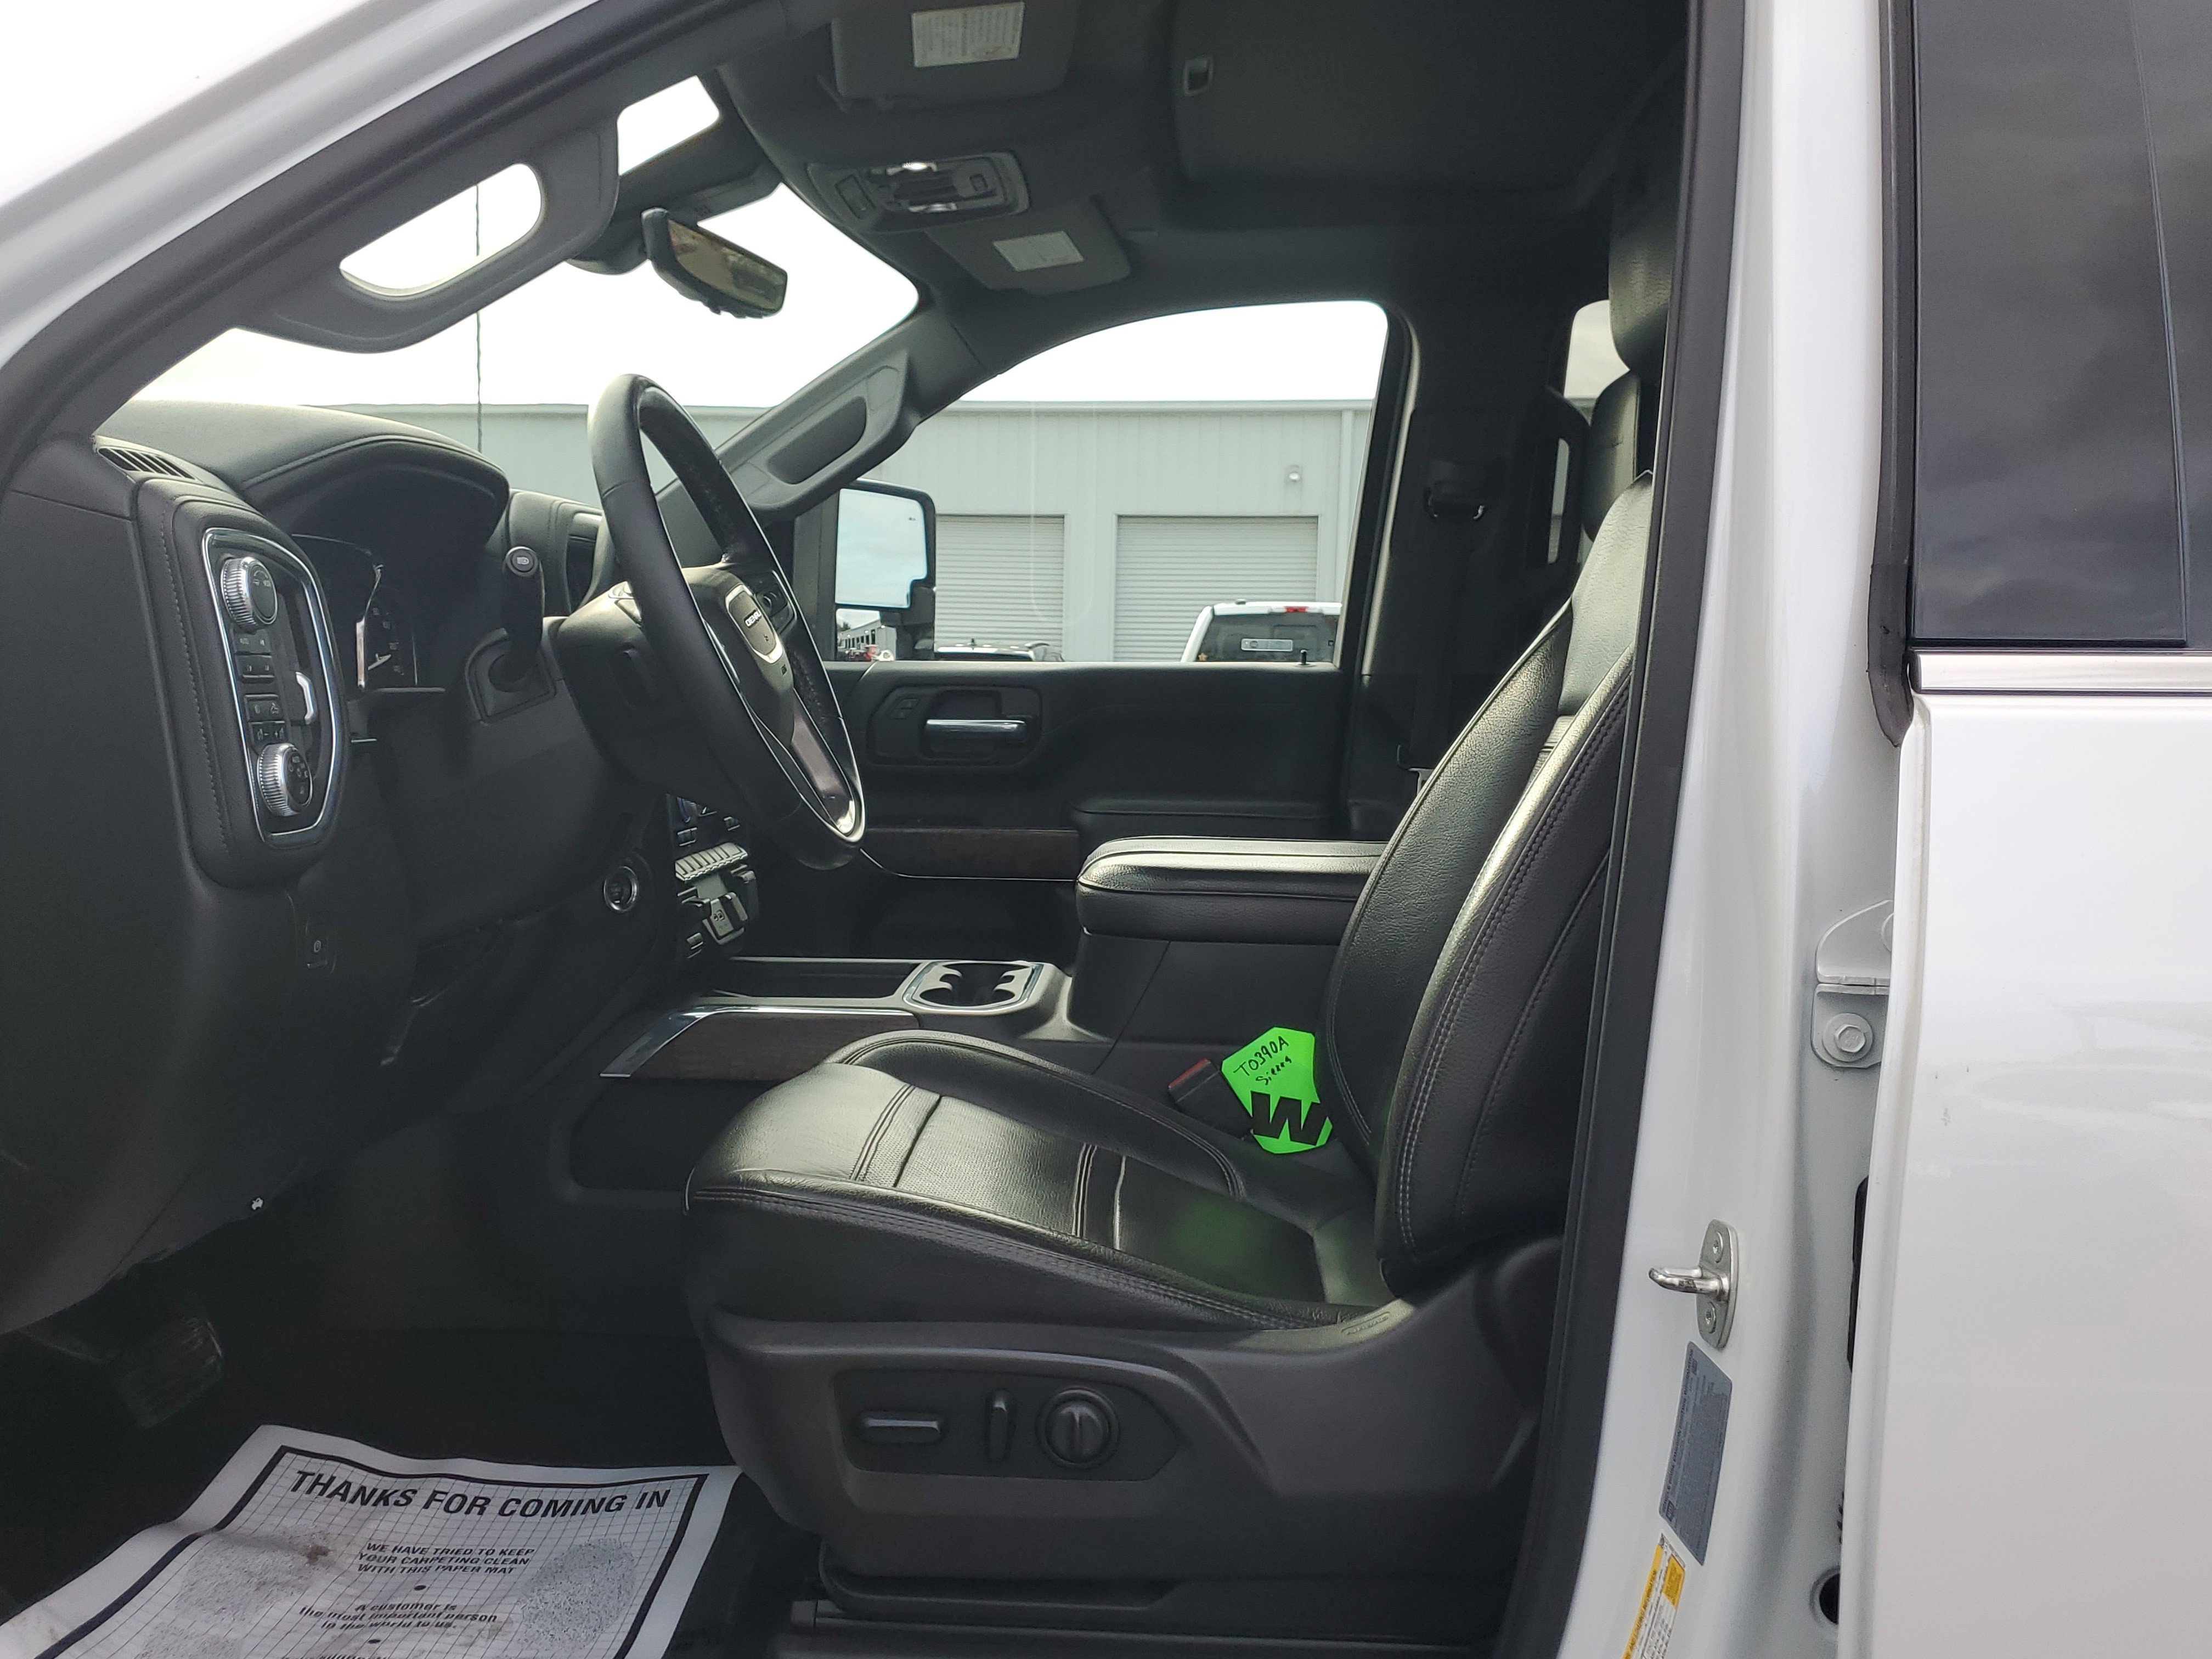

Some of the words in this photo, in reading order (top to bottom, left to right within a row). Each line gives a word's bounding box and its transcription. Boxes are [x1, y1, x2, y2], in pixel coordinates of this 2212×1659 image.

[290, 1470, 417, 1507] THANKS
[422, 1489, 491, 1516] FOR
[499, 1495, 628, 1517] COMING
[635, 1488, 671, 1509] IN
[366, 1543, 389, 1552] WE
[391, 1545, 429, 1555] HAVE
[359, 1552, 397, 1564] YOUR
[401, 1556, 480, 1565] CARPETING
[358, 1564, 397, 1574] WITH
[399, 1565, 433, 1574] THIS
[435, 1565, 481, 1573] PAPER
[370, 1602, 441, 1612] customer
[328, 1612, 366, 1621] most
[369, 1611, 443, 1621] important
[444, 1613, 497, 1623] person
